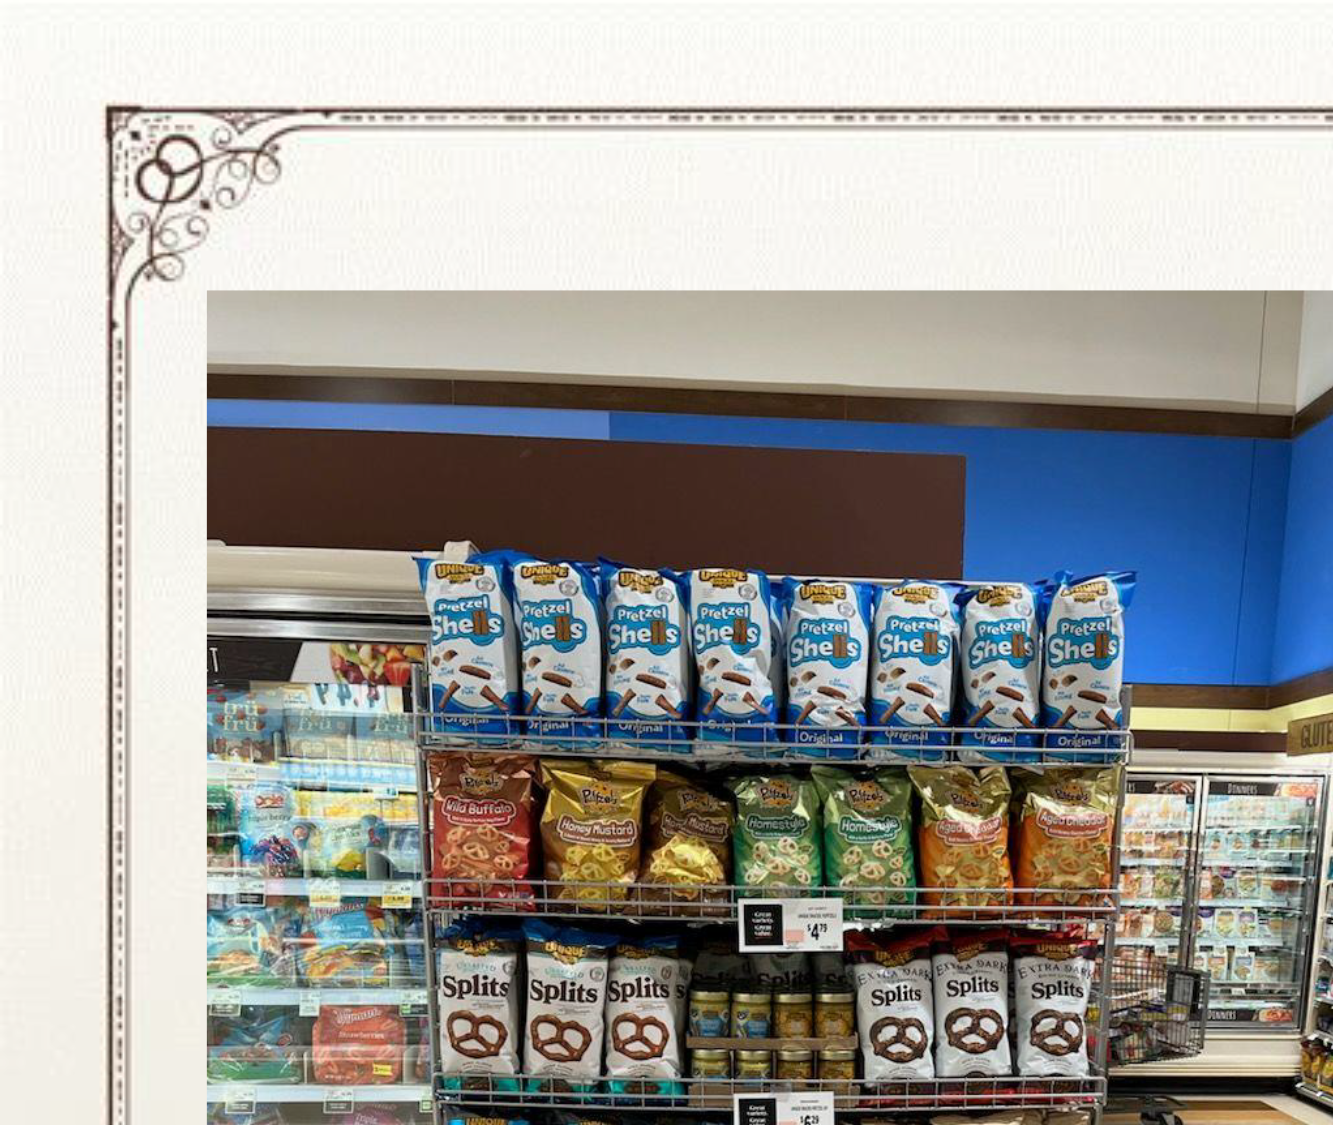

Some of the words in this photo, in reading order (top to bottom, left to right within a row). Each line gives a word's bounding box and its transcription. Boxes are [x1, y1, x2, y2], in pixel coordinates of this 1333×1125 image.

[438, 595, 488, 611] Pretzel
[523, 600, 570, 618] Pretzel
[618, 607, 666, 620] Pretzel
[701, 606, 749, 619] Pretzel
[801, 621, 847, 635] Pretzel
[891, 618, 938, 631] Pretzel
[979, 621, 1026, 635] Pretzel
[1061, 618, 1110, 634] Pretzel
[800, 732, 843, 744] Original
[1058, 737, 1101, 747] Original
[1227, 783, 1258, 795] DINNERS
[446, 801, 467, 814] Wild
[469, 802, 512, 815] Buffalo
[561, 820, 590, 835] Honey
[592, 823, 633, 836] Mustard
[530, 980, 597, 1004] Splits
[608, 978, 669, 1001] Splits
[871, 985, 921, 1007] Splits
[947, 979, 999, 998] Splits
[1032, 980, 1084, 999] Splits
